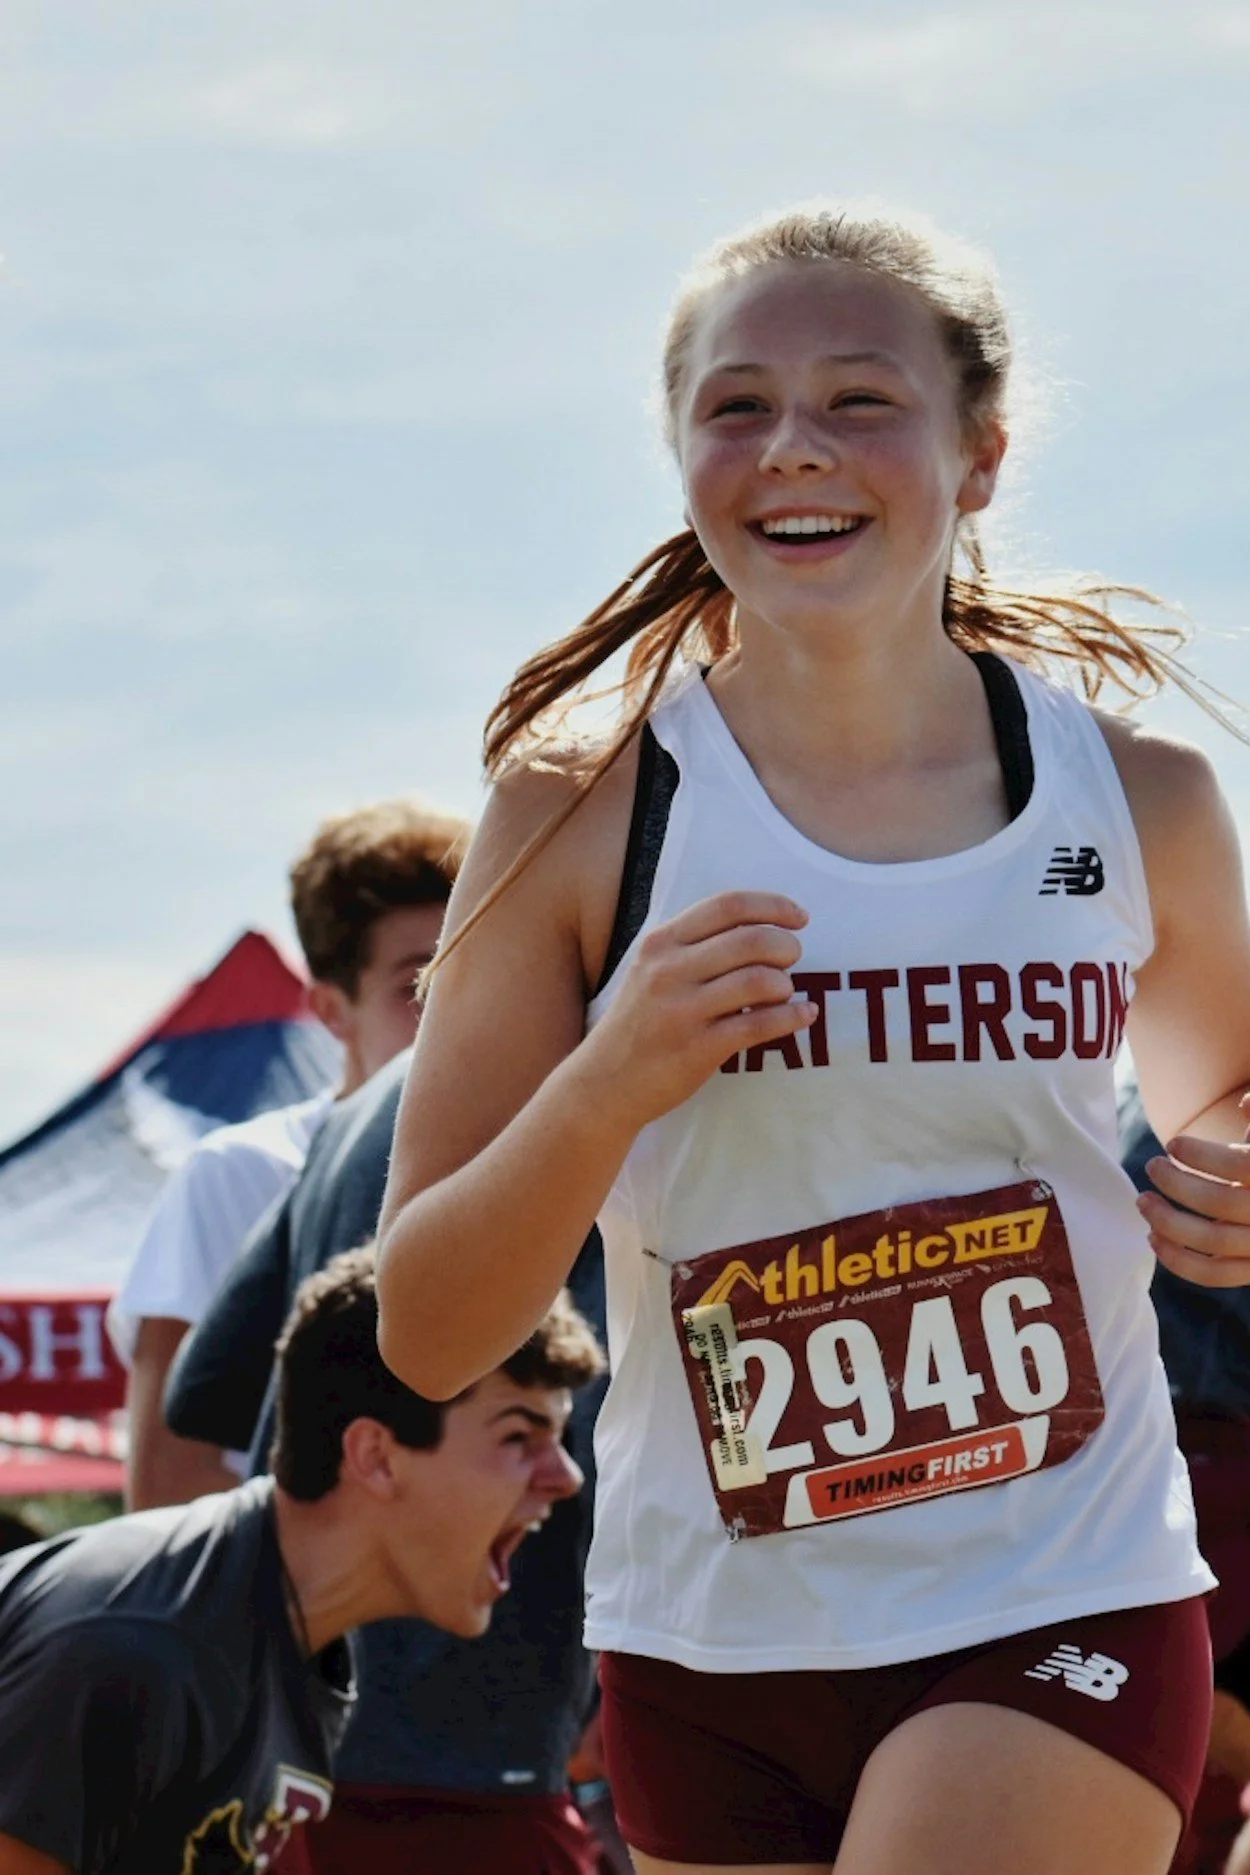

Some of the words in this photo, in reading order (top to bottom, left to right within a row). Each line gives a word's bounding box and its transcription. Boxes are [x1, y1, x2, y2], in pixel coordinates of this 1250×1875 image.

[720, 962, 1129, 1074] TTERSON
[710, 1323, 749, 1467] results.timirst.com
[733, 1276, 1069, 1476] 2946
[826, 1440, 1009, 1503] TIMINGFIRST
